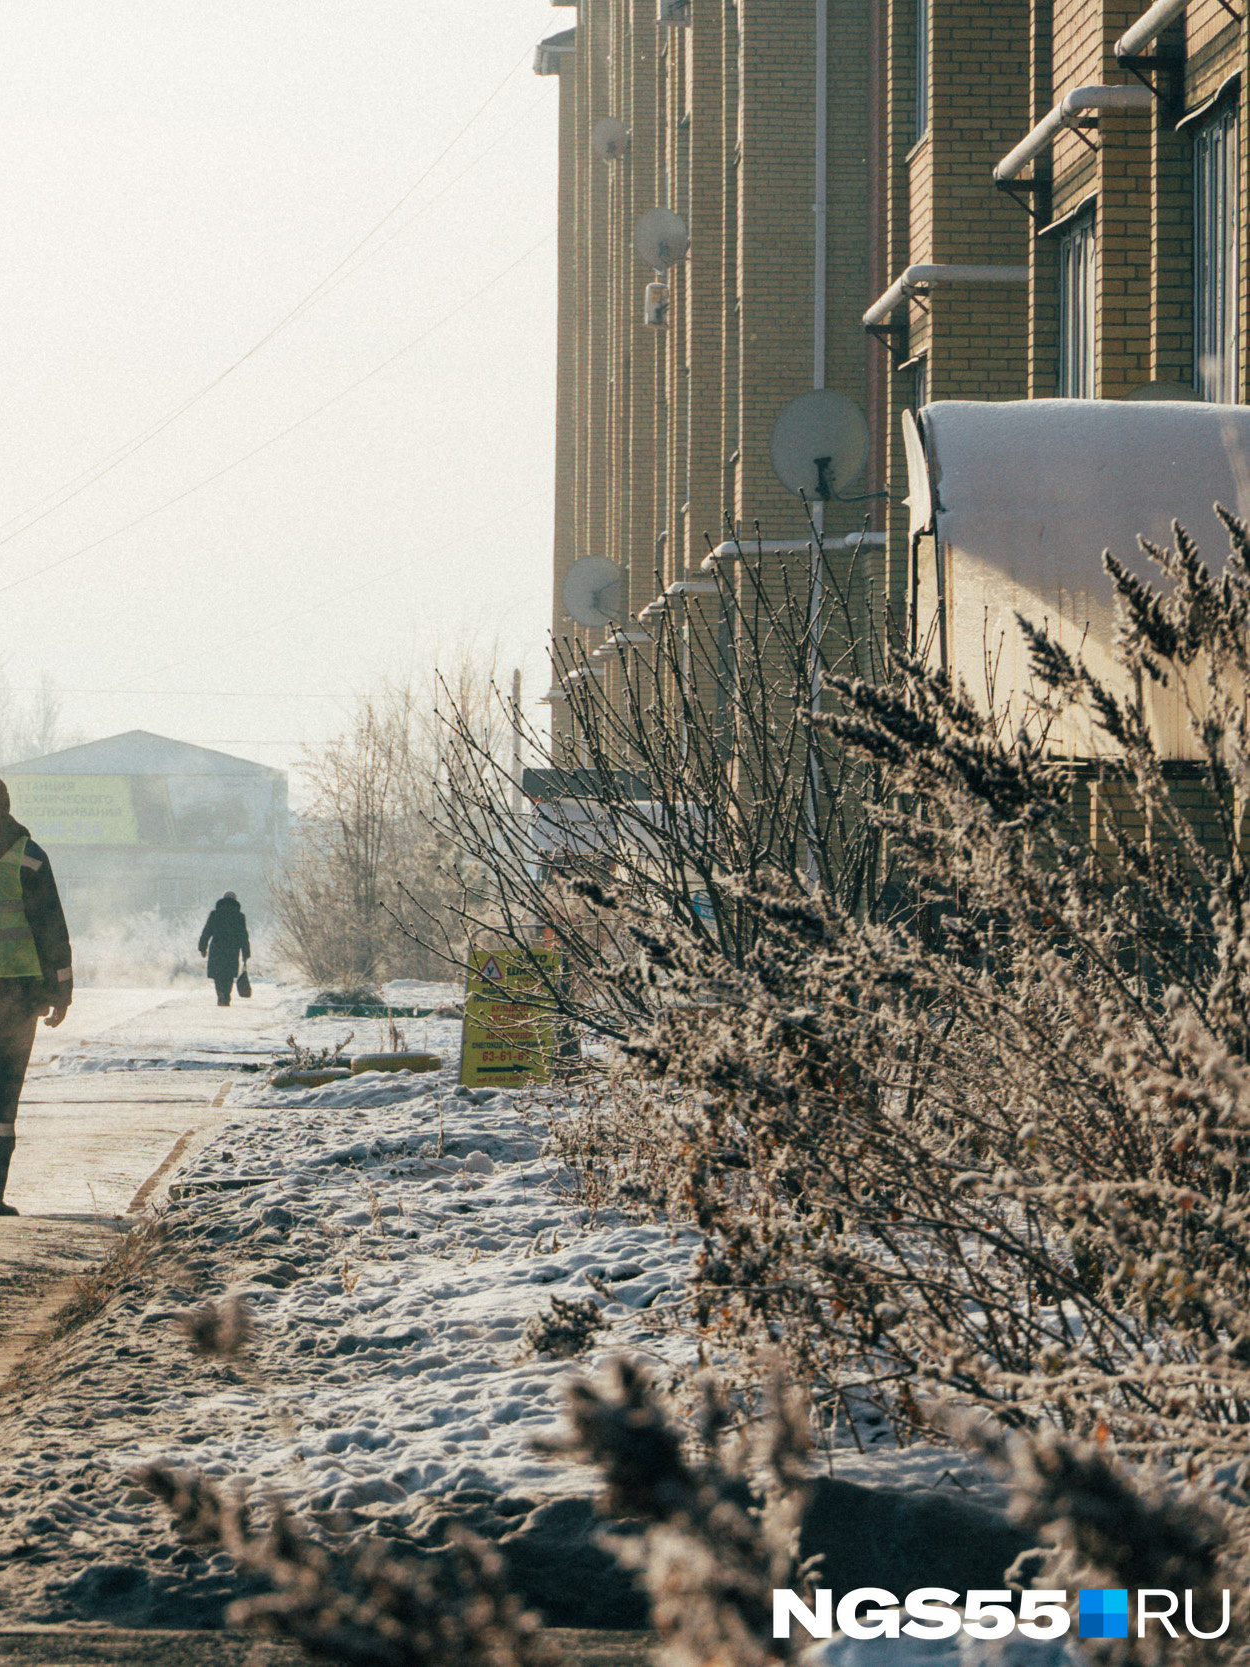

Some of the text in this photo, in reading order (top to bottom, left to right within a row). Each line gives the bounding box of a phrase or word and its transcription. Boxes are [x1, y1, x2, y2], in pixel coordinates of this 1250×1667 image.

[17, 781, 76, 792] СТАНЦИЯ
[17, 794, 114, 804] ТЕХНИЧЕСКОГО
[16, 806, 122, 817] ОБСЛУЖИВАНИЯ
